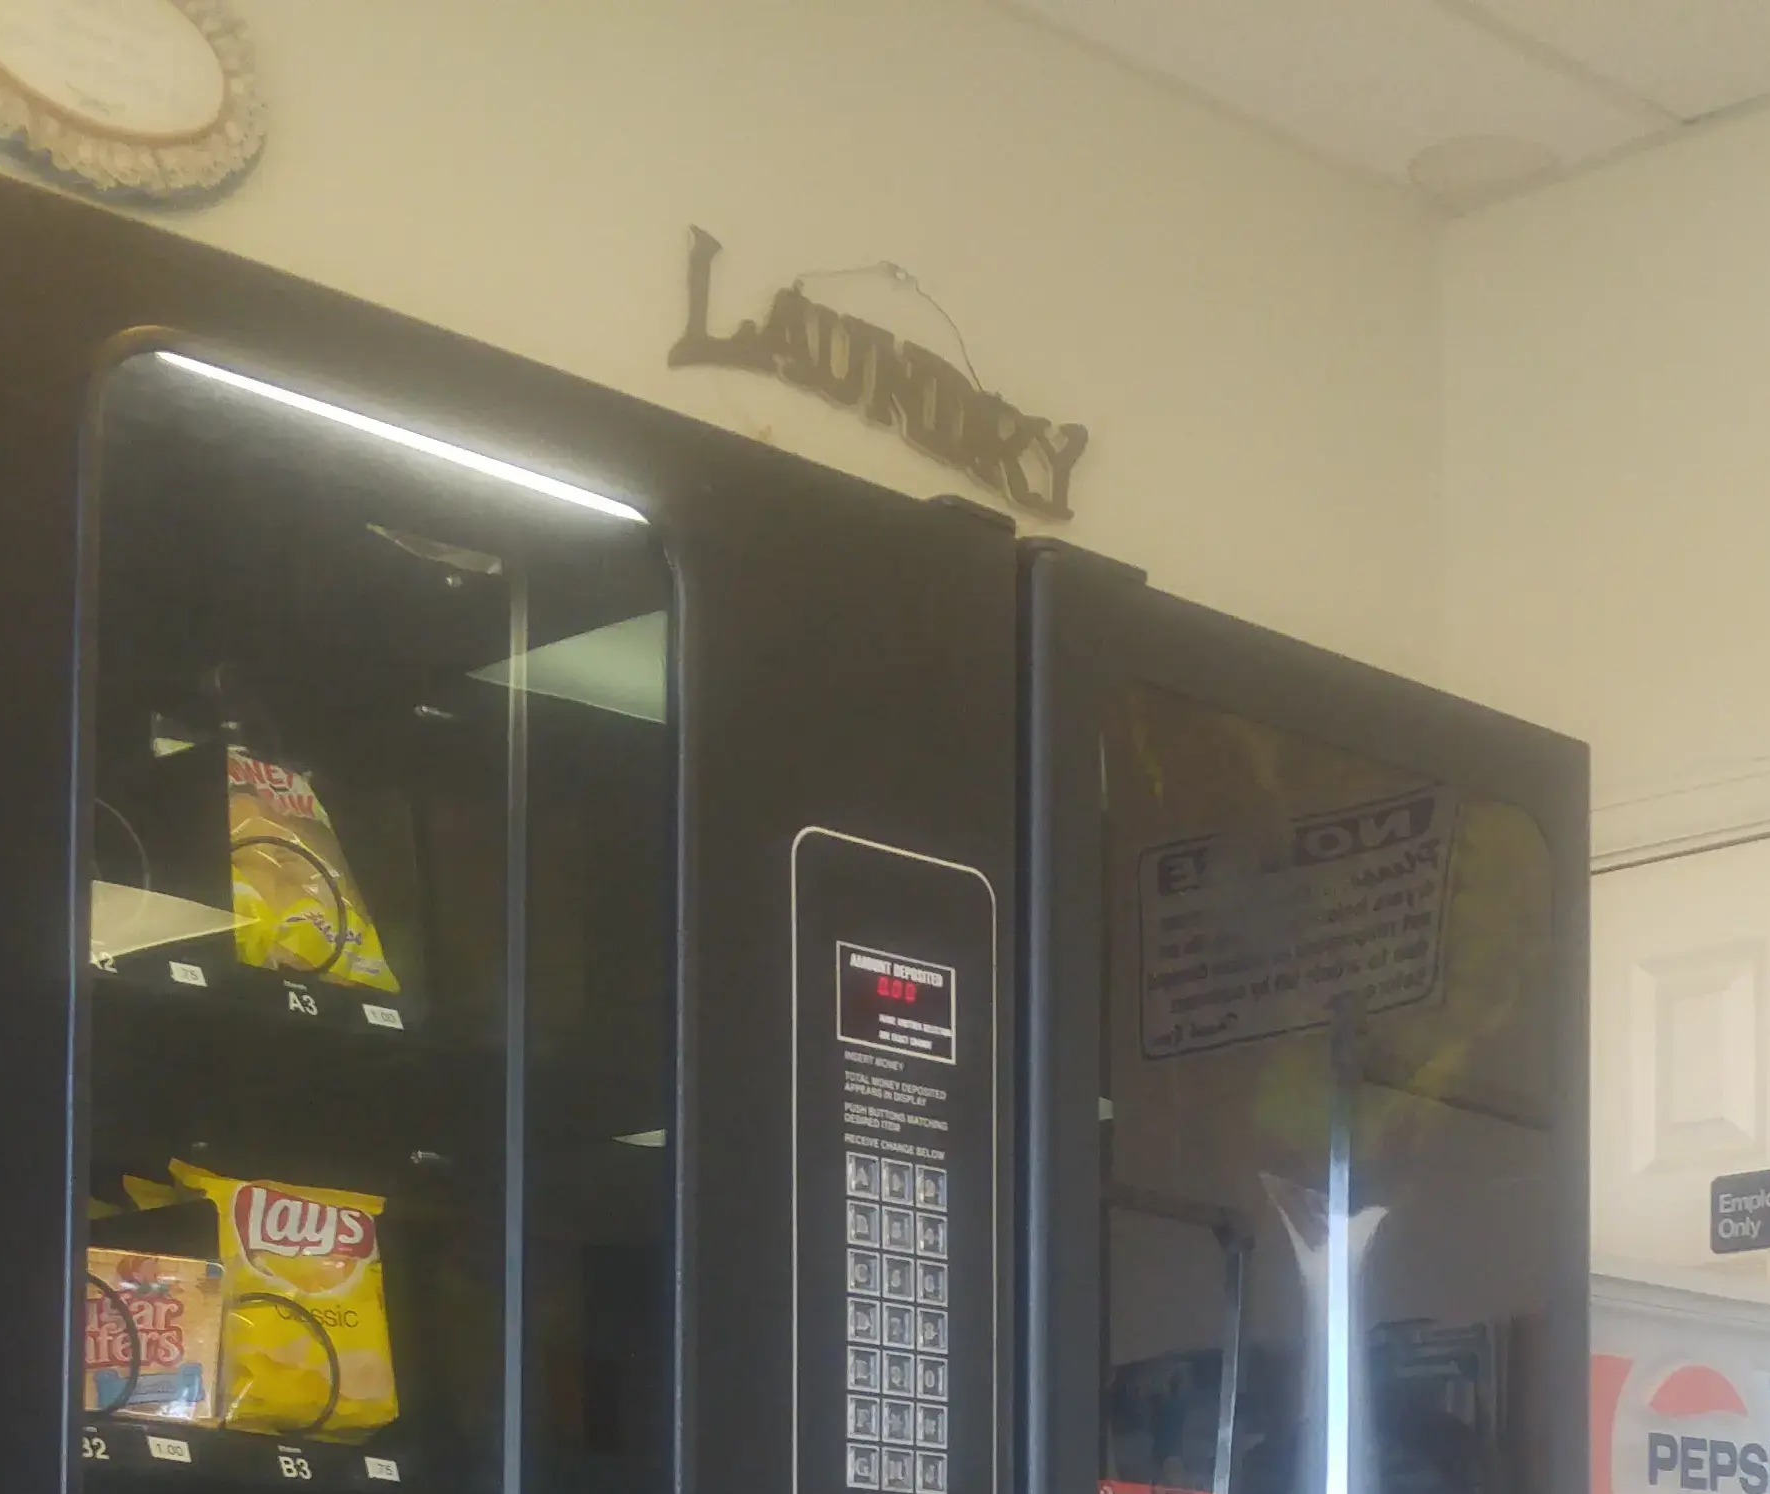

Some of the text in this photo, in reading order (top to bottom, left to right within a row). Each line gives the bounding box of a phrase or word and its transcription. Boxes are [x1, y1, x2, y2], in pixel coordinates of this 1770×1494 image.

[289, 991, 318, 1016] A3
[1718, 1216, 1761, 1239] Only
[278, 1456, 312, 1480] B3
